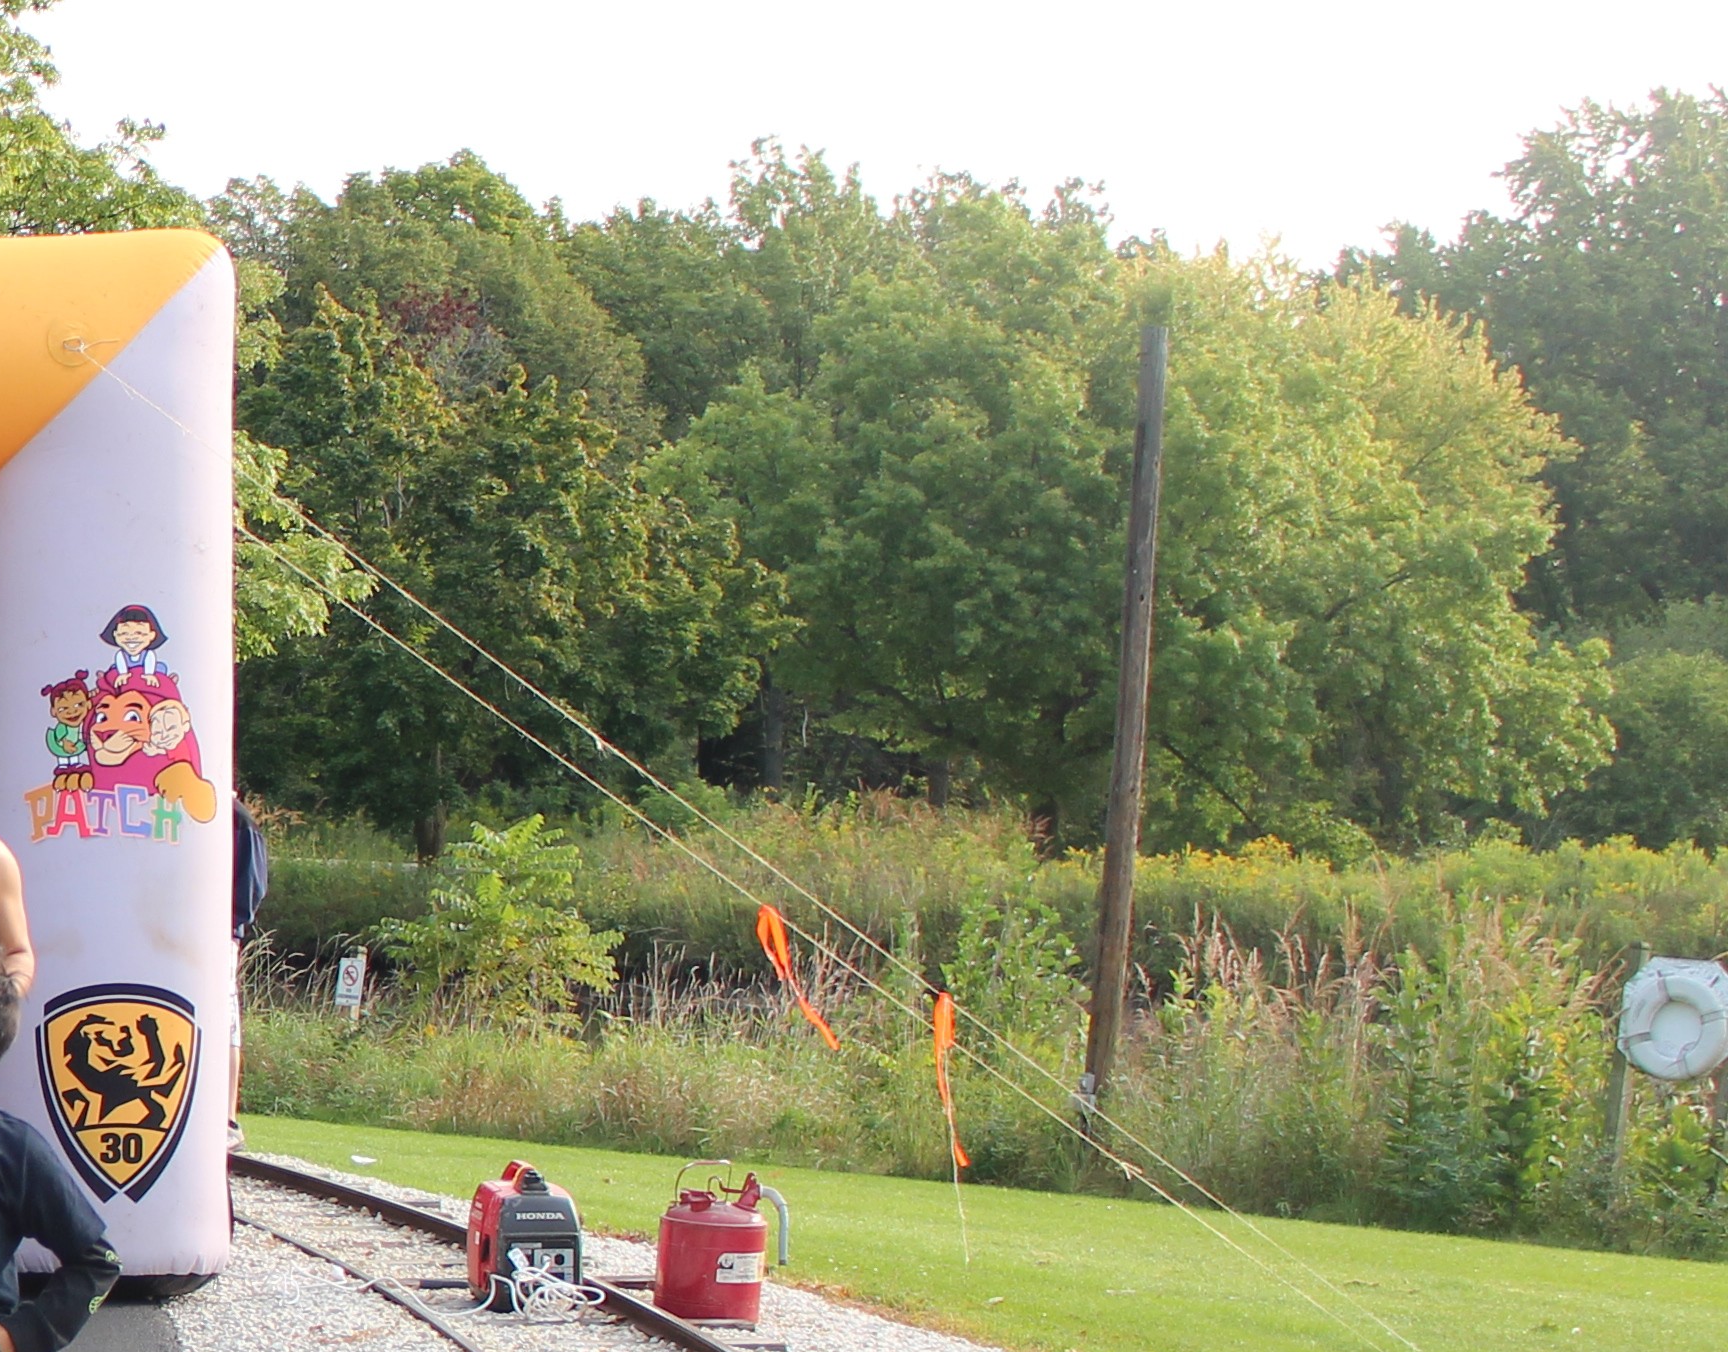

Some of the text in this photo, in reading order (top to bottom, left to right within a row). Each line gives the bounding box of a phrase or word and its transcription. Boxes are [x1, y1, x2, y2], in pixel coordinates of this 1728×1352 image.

[24, 783, 183, 844] PATCH
[99, 1132, 143, 1165] 30
[515, 1212, 565, 1220] HONDA
